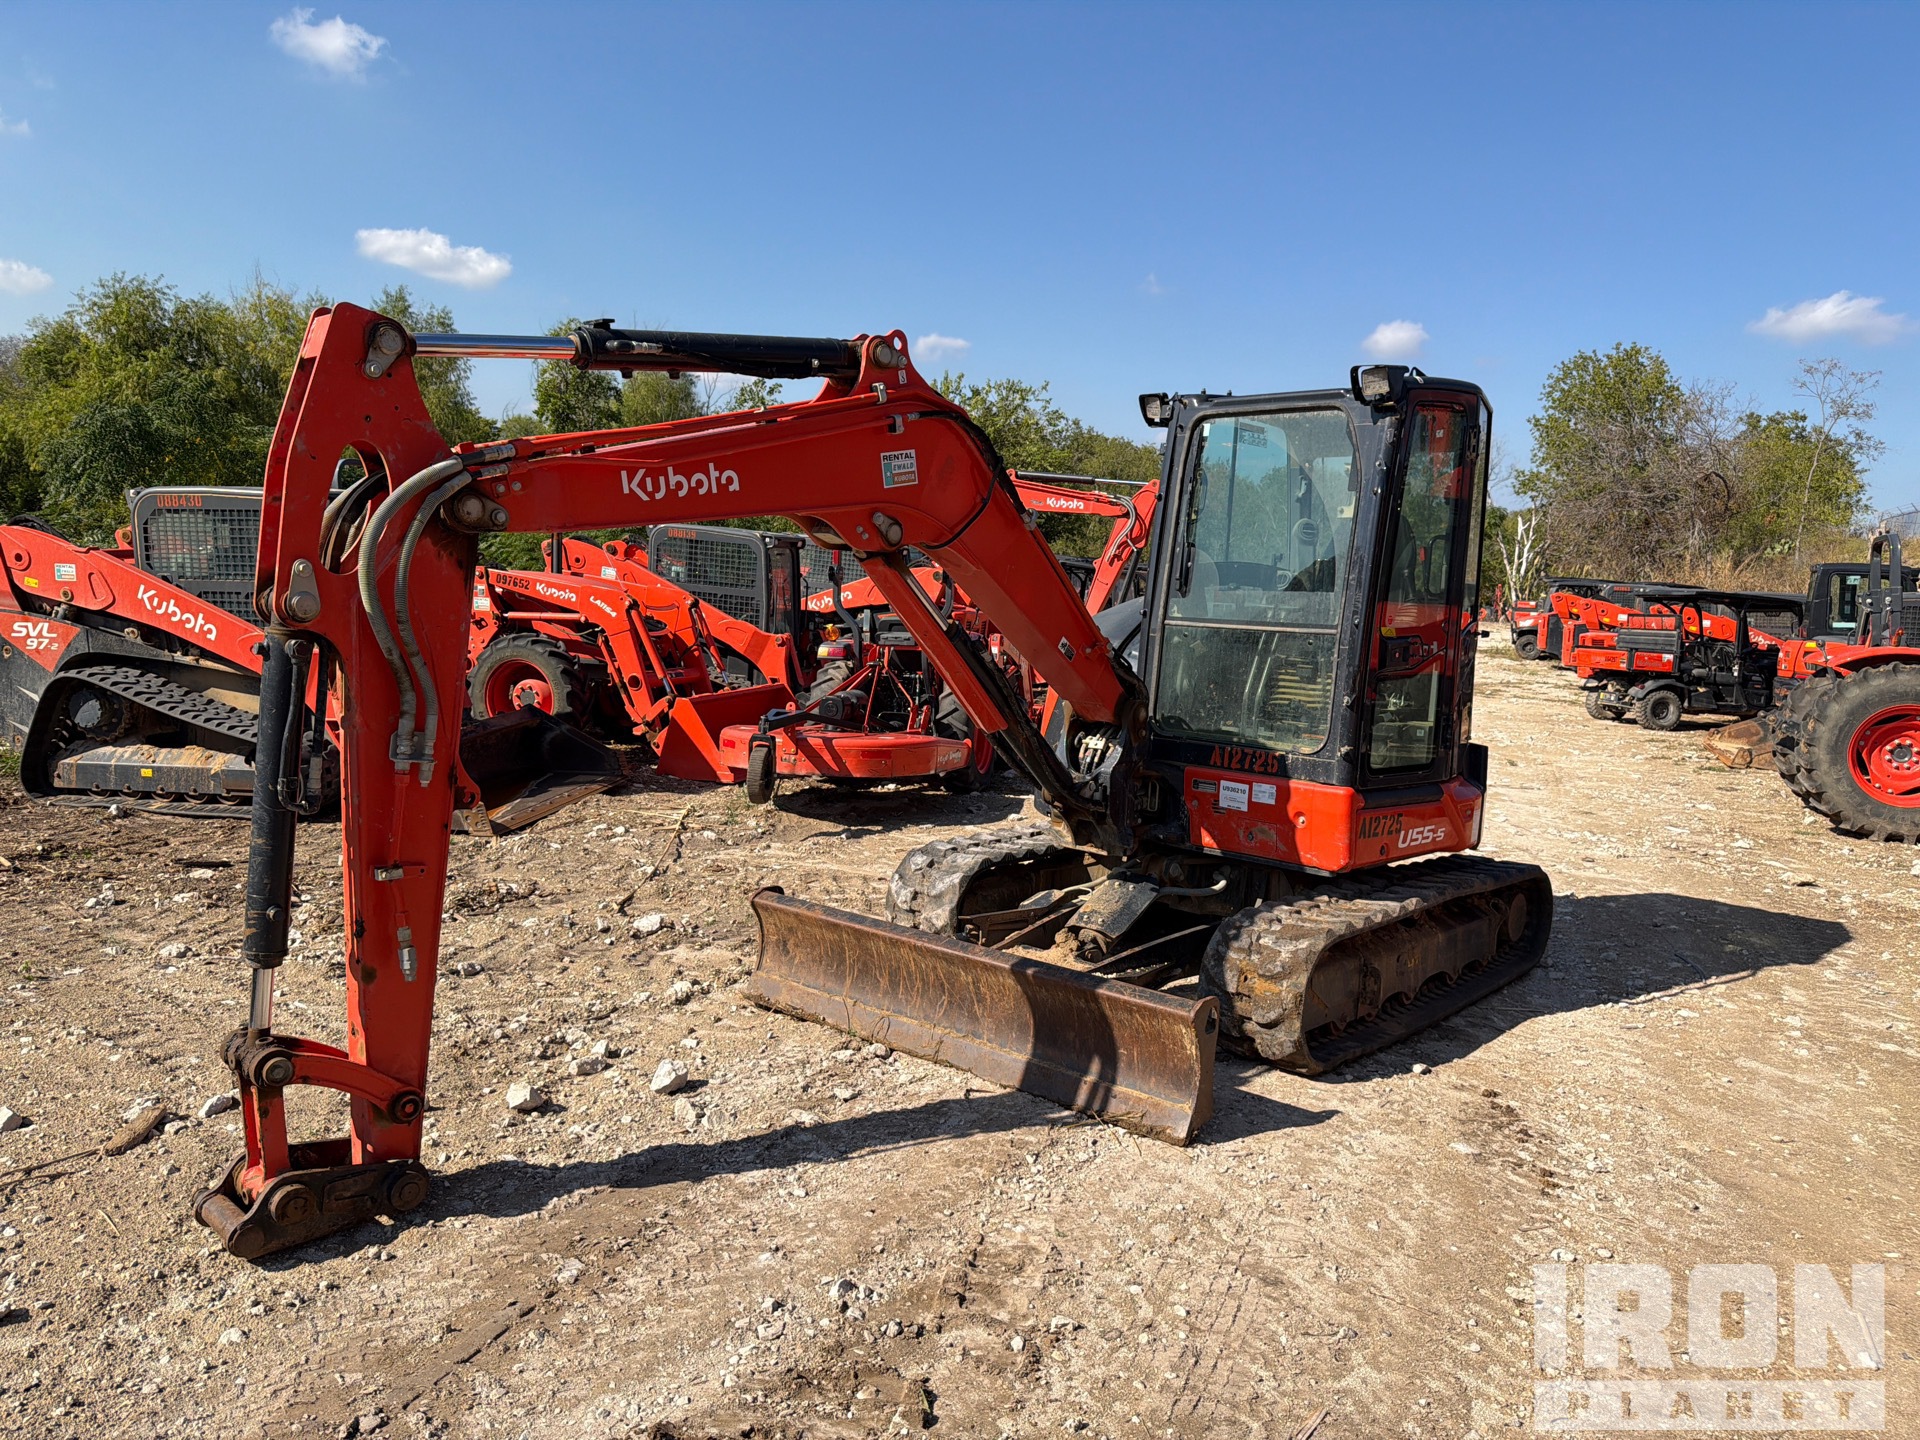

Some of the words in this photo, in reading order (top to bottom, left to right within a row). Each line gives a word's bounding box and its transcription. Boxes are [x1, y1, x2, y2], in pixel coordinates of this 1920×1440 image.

[882, 452, 915, 462] RENTAL
[893, 462, 914, 471] EWALD
[620, 462, 740, 501] Kubota
[156, 495, 203, 507] 088430
[1046, 497, 1085, 510] Kubota
[495, 573, 531, 590] 097652
[535, 582, 577, 602] Kubota
[137, 584, 218, 641] Kubota
[11, 622, 58, 637] SVL
[26, 638, 58, 649] 97-2
[1209, 744, 1280, 773] A12725
[1358, 813, 1404, 839] A12725
[1397, 825, 1446, 848] U55-5
